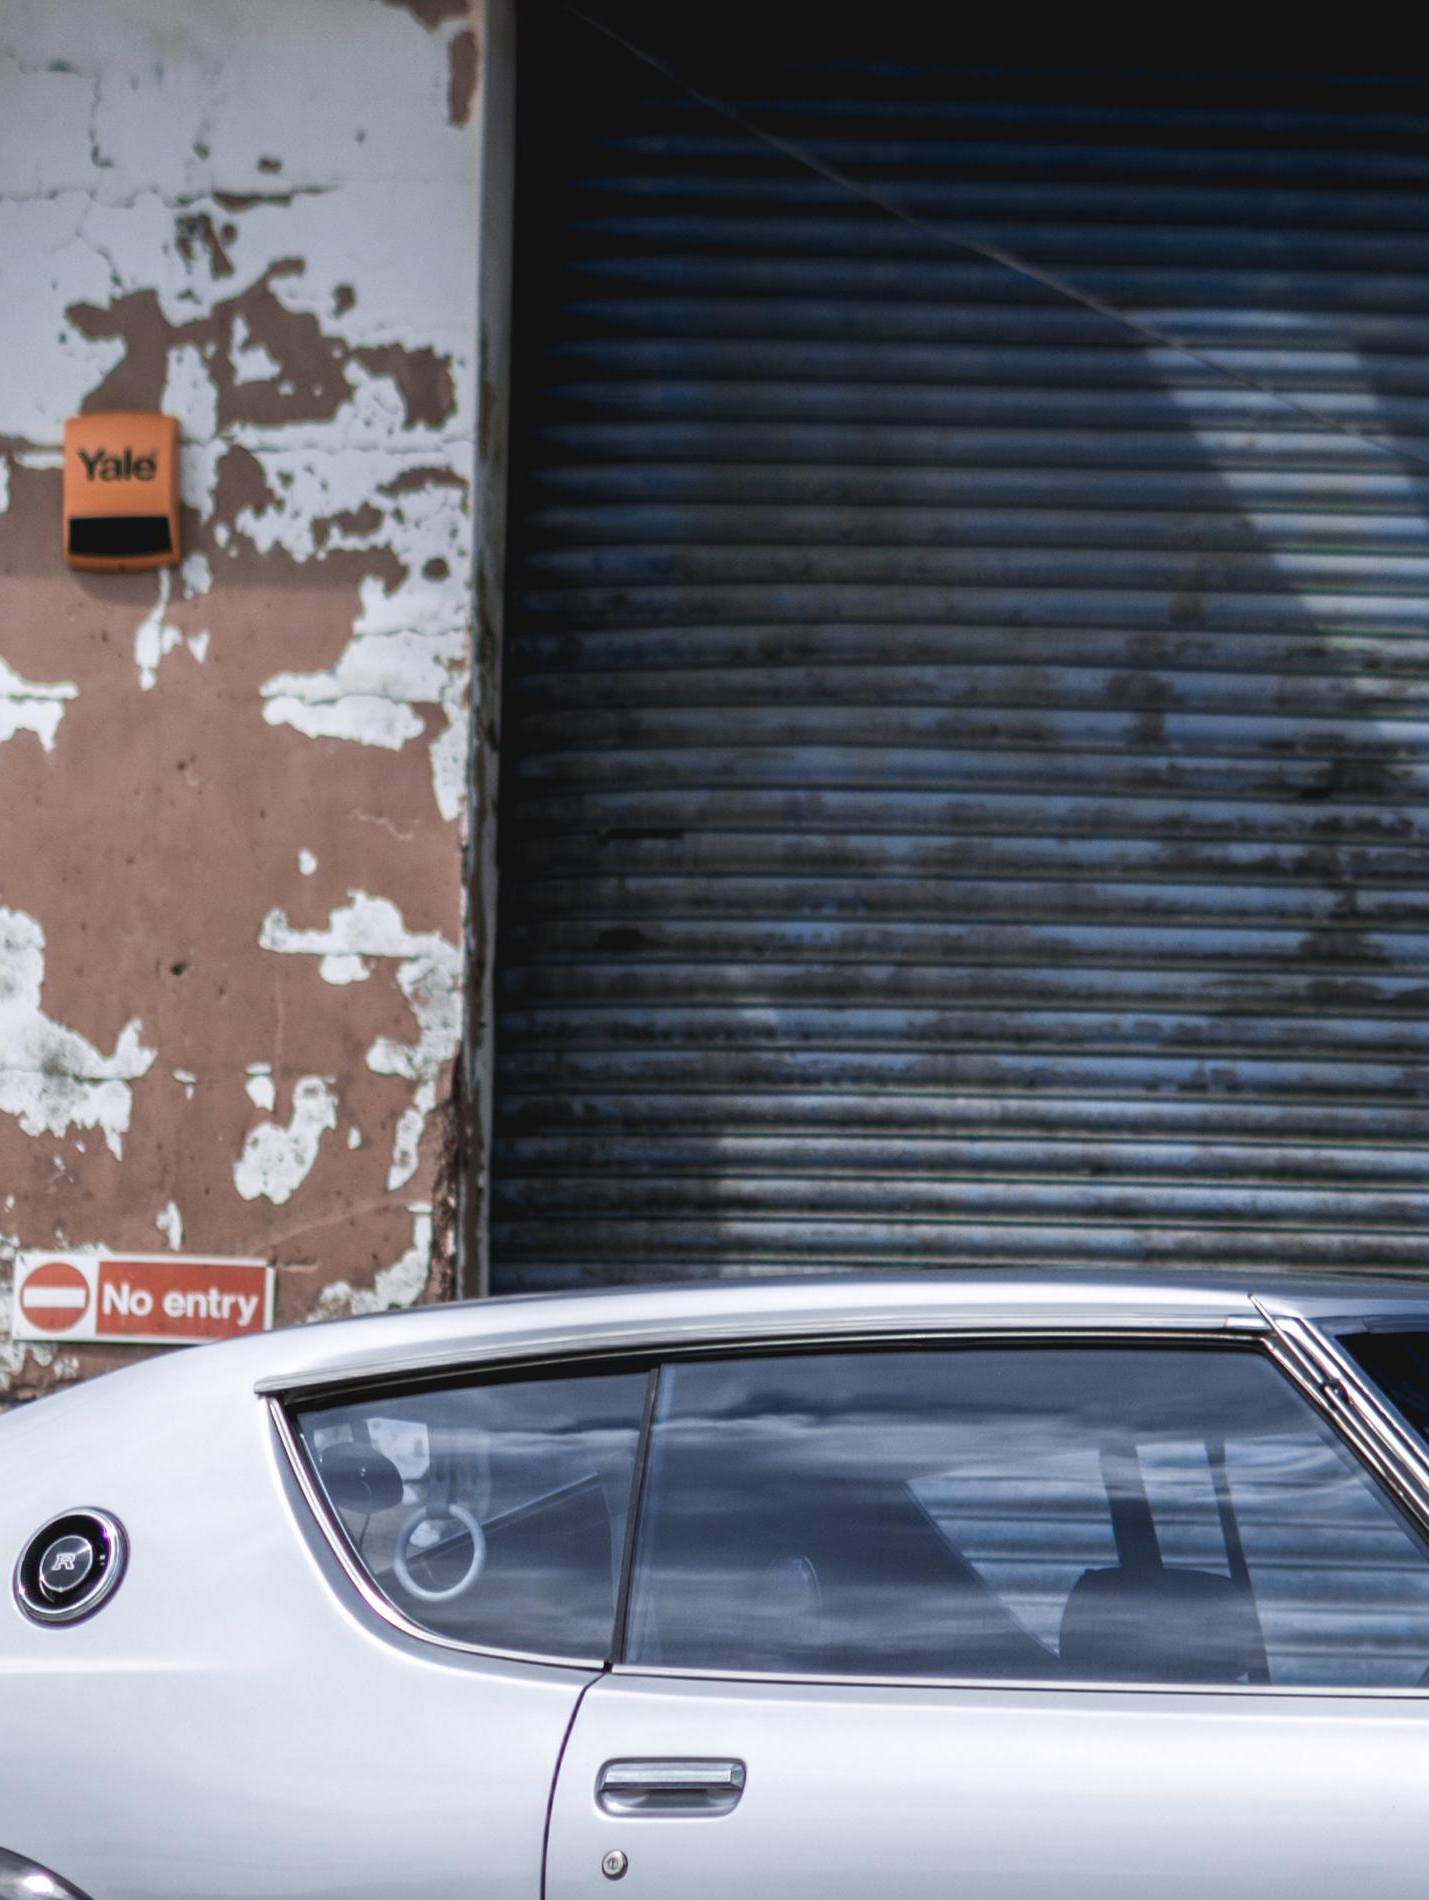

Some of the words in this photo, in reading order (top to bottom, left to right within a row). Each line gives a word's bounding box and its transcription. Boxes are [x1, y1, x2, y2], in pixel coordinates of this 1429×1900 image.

[76, 446, 158, 482] Yale
[101, 1281, 154, 1317] No
[162, 1287, 260, 1328] entry
